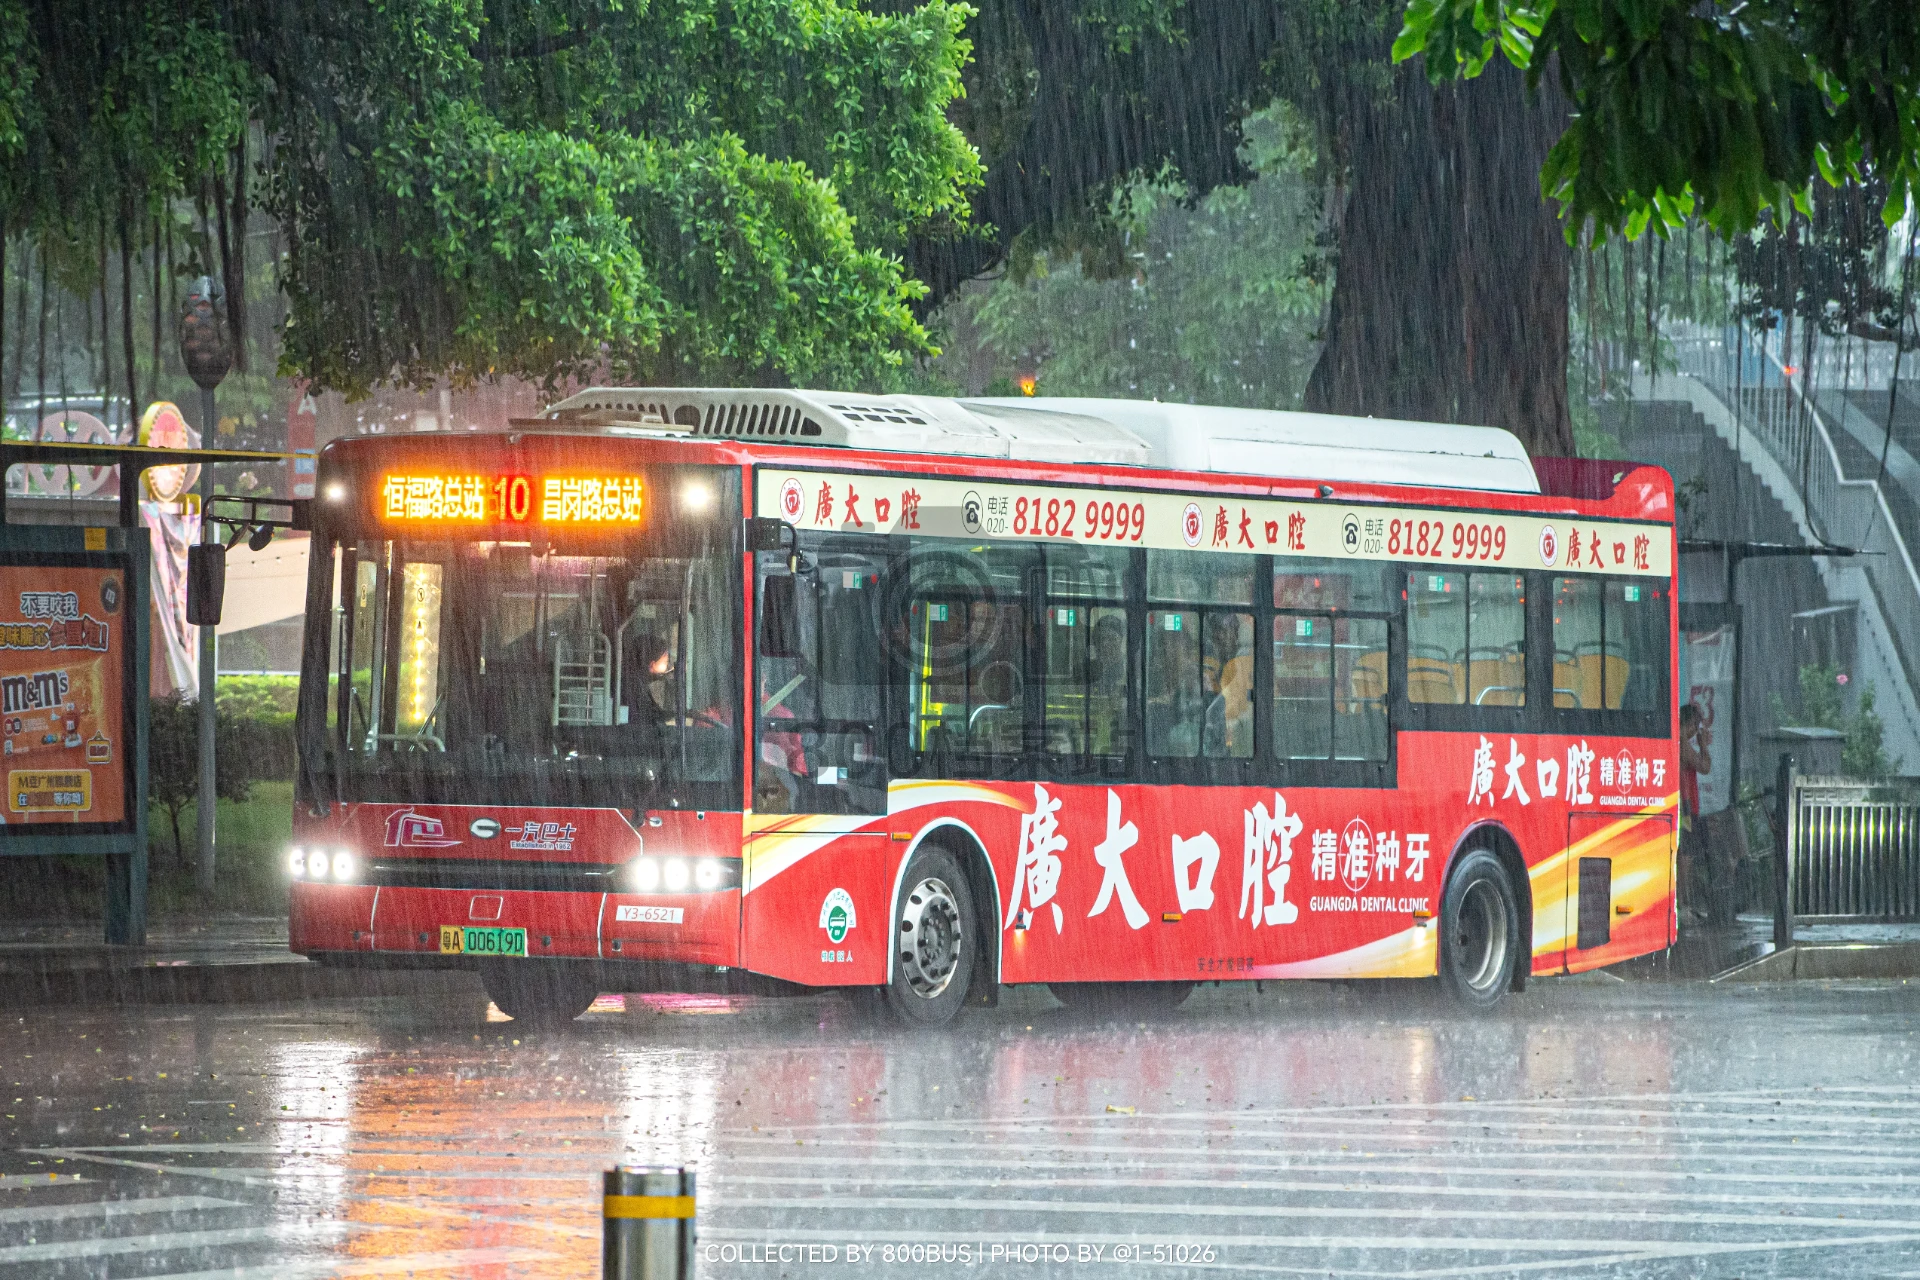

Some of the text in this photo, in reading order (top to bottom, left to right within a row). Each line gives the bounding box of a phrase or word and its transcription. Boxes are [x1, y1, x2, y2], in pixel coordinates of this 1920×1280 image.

[384, 476, 484, 519] 恒福路总站
[494, 477, 530, 520] 10
[543, 478, 642, 522] 昌岗路总站
[814, 480, 922, 530] 廣大口腔
[987, 496, 1009, 516] 电话
[1013, 496, 1145, 541] 8182 9999
[986, 517, 1009, 534] 020-
[1212, 505, 1306, 551] 廣大口腔
[1364, 539, 1384, 554] 020-
[1365, 519, 1384, 537] 电话
[1387, 518, 1507, 561] 8182 9999
[1566, 527, 1650, 570] 廣大口腔
[21, 592, 78, 617] 不要咬我
[1467, 735, 1596, 807] 廣大口腔
[1600, 757, 1666, 787] 精准种牙
[1600, 795, 1627, 806] GUANGDA
[1628, 796, 1648, 807] DENTAL
[505, 821, 577, 842] 一汽巴士
[1004, 783, 1303, 934] 廣大口腔
[1311, 828, 1430, 882] 精准种牙
[624, 907, 675, 921] Y3-6521
[1309, 896, 1429, 913] GUANGDA DENTAL CLINIC
